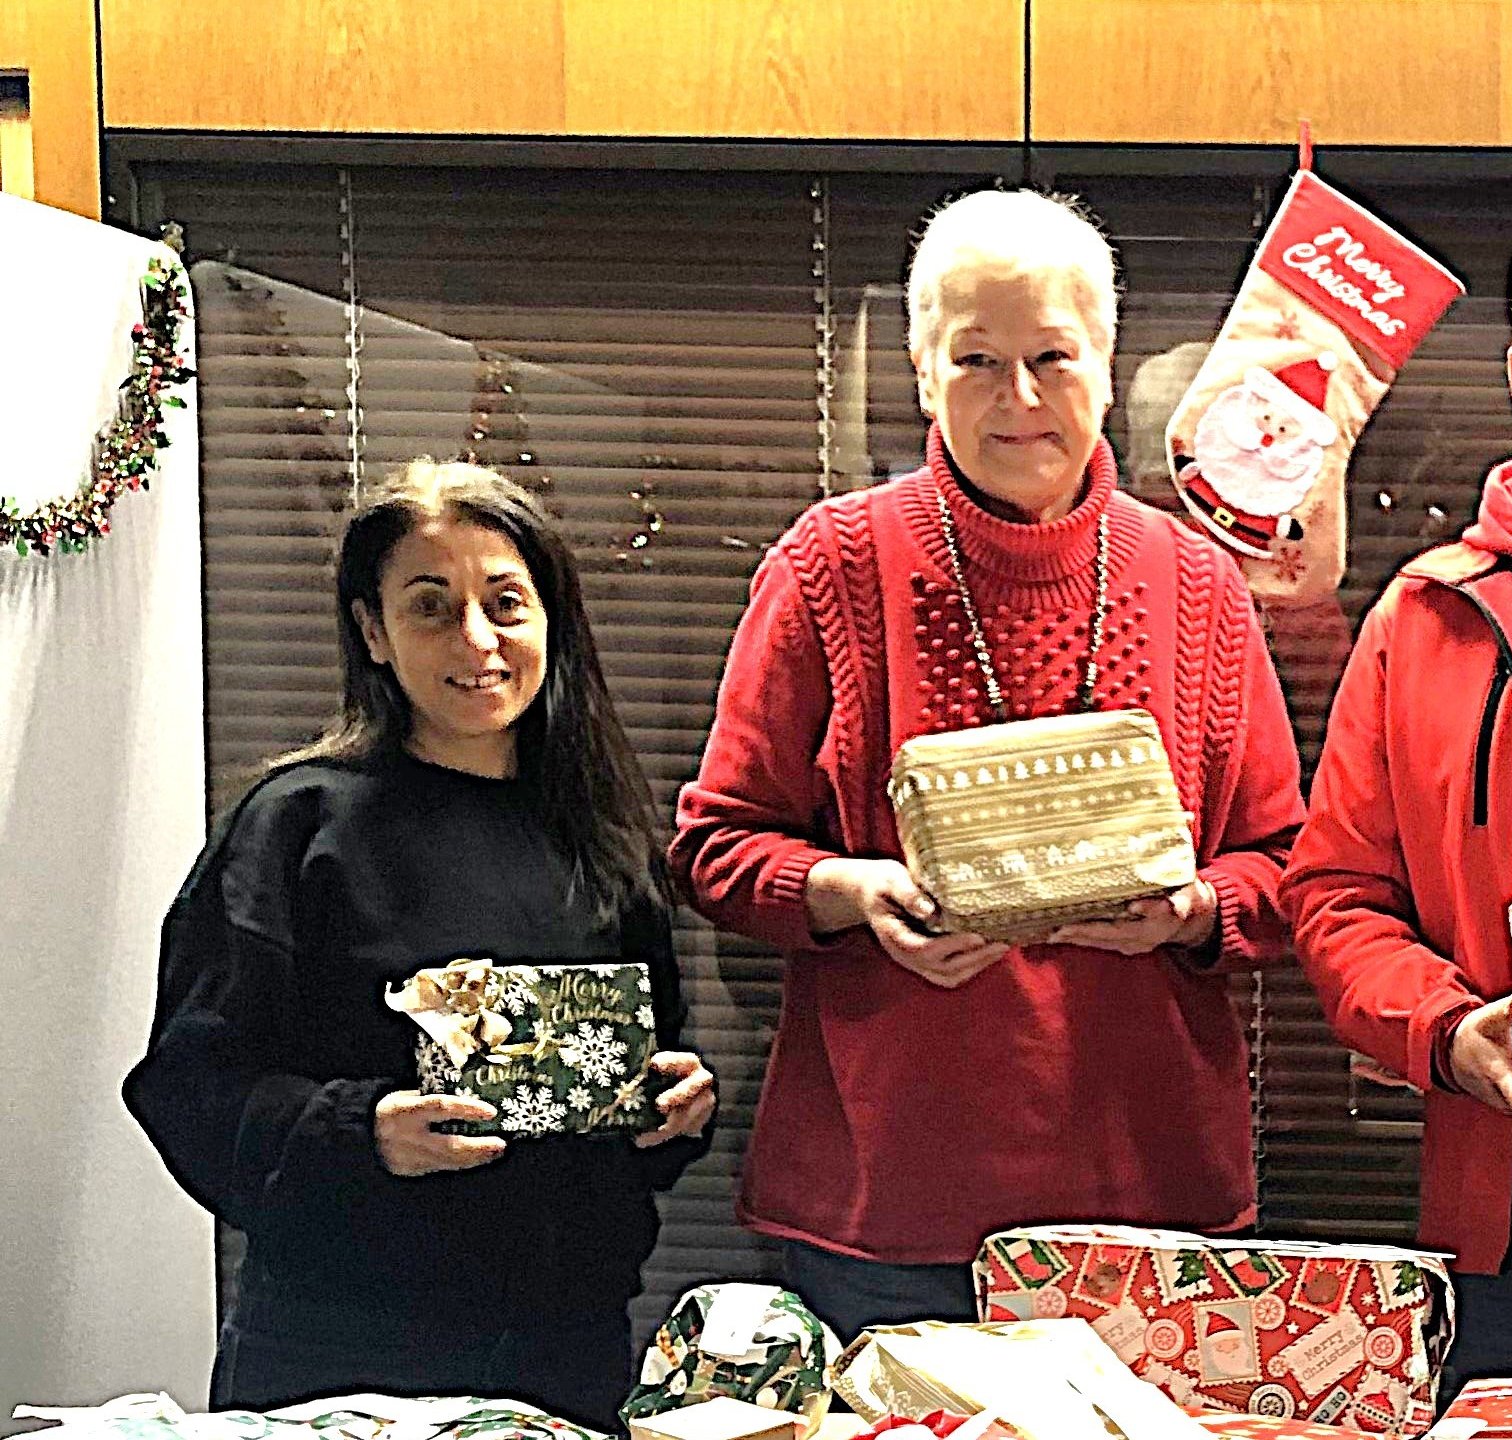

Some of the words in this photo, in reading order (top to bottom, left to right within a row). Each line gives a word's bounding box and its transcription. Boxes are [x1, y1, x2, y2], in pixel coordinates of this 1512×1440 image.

[1313, 226, 1405, 304] Merry
[1283, 242, 1407, 336] Christmas
[553, 971, 622, 1006] Merry
[1302, 1334, 1364, 1381] Christmas
[1303, 1329, 1344, 1361] Merry
[1330, 1391, 1347, 1409] HO
